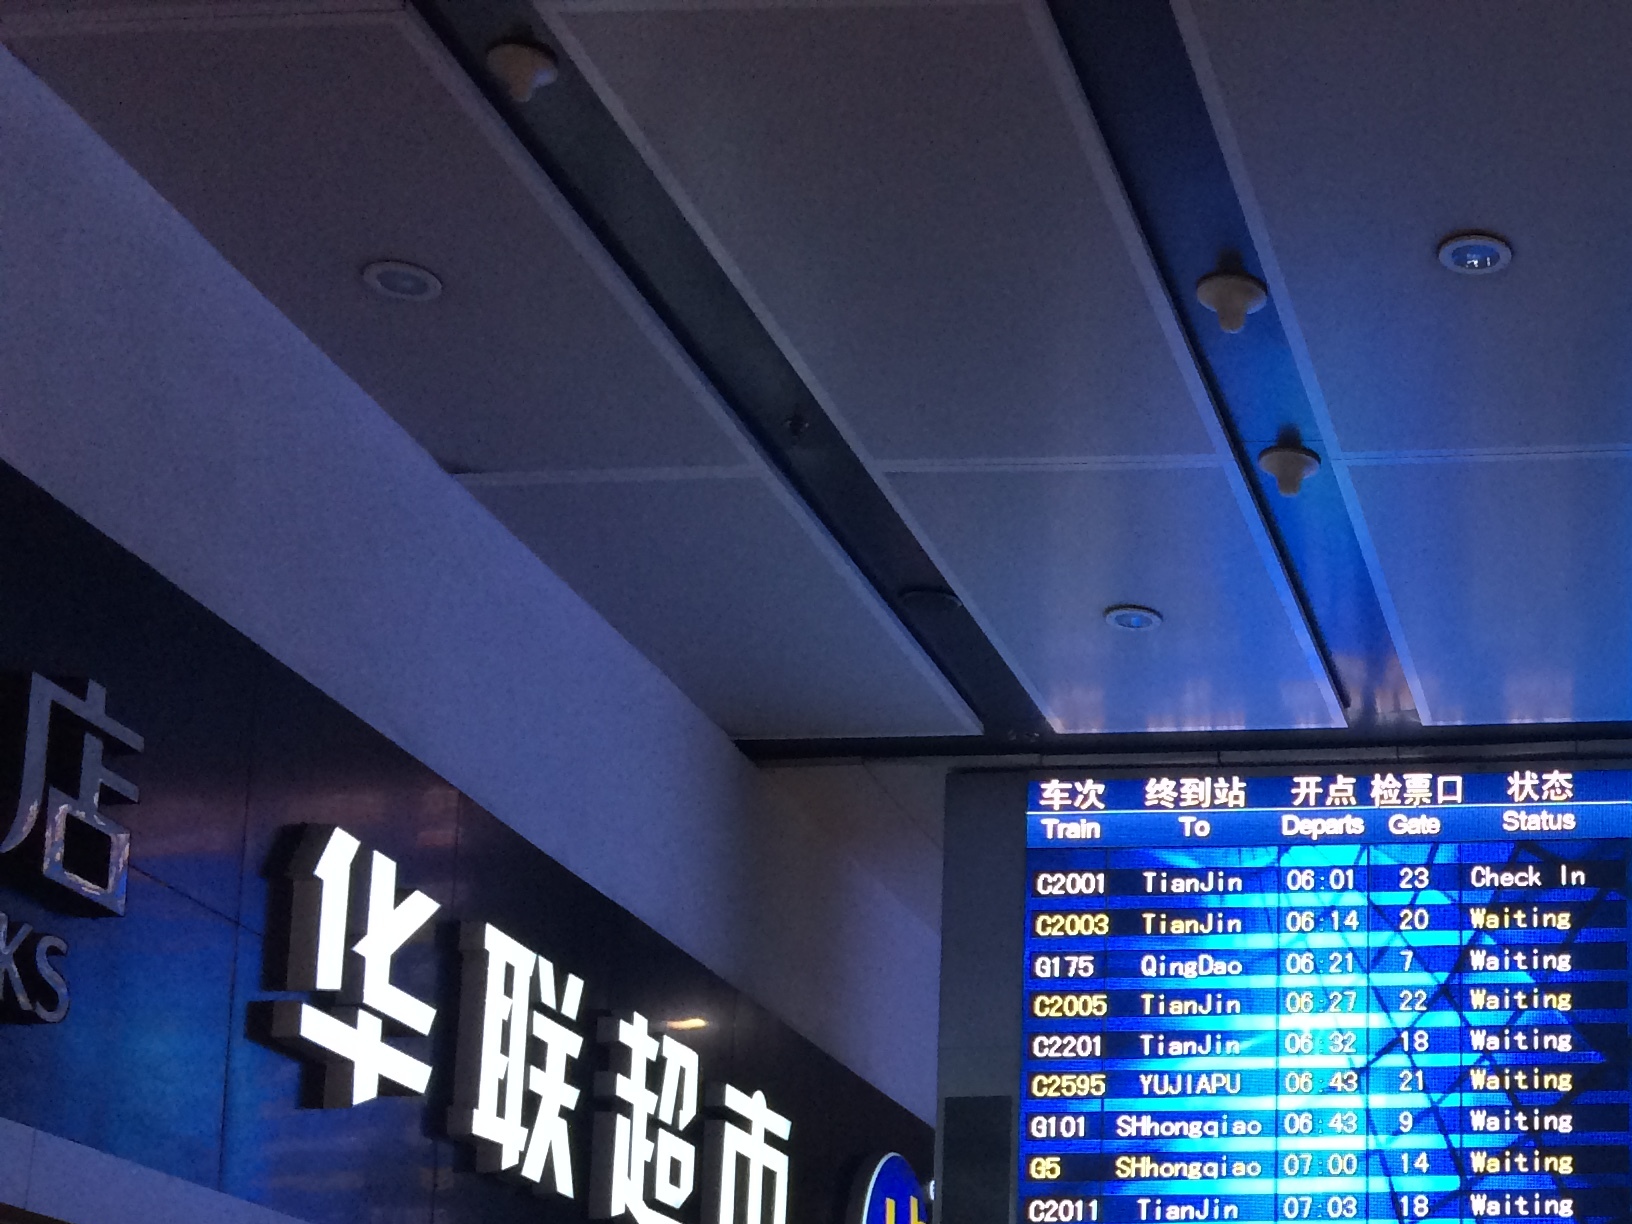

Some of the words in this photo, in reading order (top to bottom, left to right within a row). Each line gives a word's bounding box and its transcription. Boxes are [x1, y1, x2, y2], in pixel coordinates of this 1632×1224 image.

[0, 671, 145, 917] 店
[1039, 781, 1105, 809] 车次
[1145, 778, 1246, 808] 终到站
[1291, 776, 1356, 806] 开点
[1370, 774, 1462, 806] 检票口
[1507, 771, 1573, 801] 状态
[1042, 818, 1100, 839] Train
[1179, 816, 1210, 837] To
[1282, 816, 1364, 838] Departs
[1388, 814, 1440, 834] Gate
[1502, 810, 1576, 831] Status
[1037, 873, 1106, 894] C2001
[1144, 872, 1242, 893] TianJin
[1286, 870, 1354, 890] 06:01
[1400, 868, 1429, 888] 23
[1471, 866, 1542, 886] Check
[1560, 866, 1585, 886] In
[1036, 915, 1108, 936] C2003
[1142, 914, 1242, 934] TianJin
[1286, 912, 1359, 930] 06:14
[1400, 910, 1429, 930] 20
[1470, 908, 1571, 930] Waiting
[1035, 957, 1094, 977] G175
[1141, 956, 1242, 977] QingDao
[1400, 952, 1413, 972] 7
[1470, 950, 1571, 972] Waiting
[1034, 996, 1108, 1016] C2005
[1141, 994, 1240, 1015] TianJin
[1400, 991, 1428, 1012] 22
[1470, 990, 1571, 1012] Waiting
[1033, 1036, 1101, 1057] C2201
[1140, 1034, 1240, 1055] TianJin
[1400, 1032, 1428, 1052] 18
[1470, 1031, 1572, 1052] Waiting
[1032, 1075, 1106, 1096] C2595
[1140, 1074, 1241, 1093] YUJIAPU
[1400, 1071, 1424, 1091] 21
[1470, 1070, 1572, 1092] Waiting
[1031, 1116, 1086, 1138] G101
[1400, 1112, 1413, 1132] 9
[1470, 1112, 1572, 1132] Waiting
[1030, 1158, 1060, 1179] G5
[1401, 1153, 1429, 1173] 14
[1470, 1152, 1572, 1174] Waiting
[1028, 1200, 1098, 1222] C2011
[1138, 1200, 1238, 1220] TianJin
[1400, 1196, 1428, 1216] 18
[1471, 1195, 1573, 1216] Waiting
